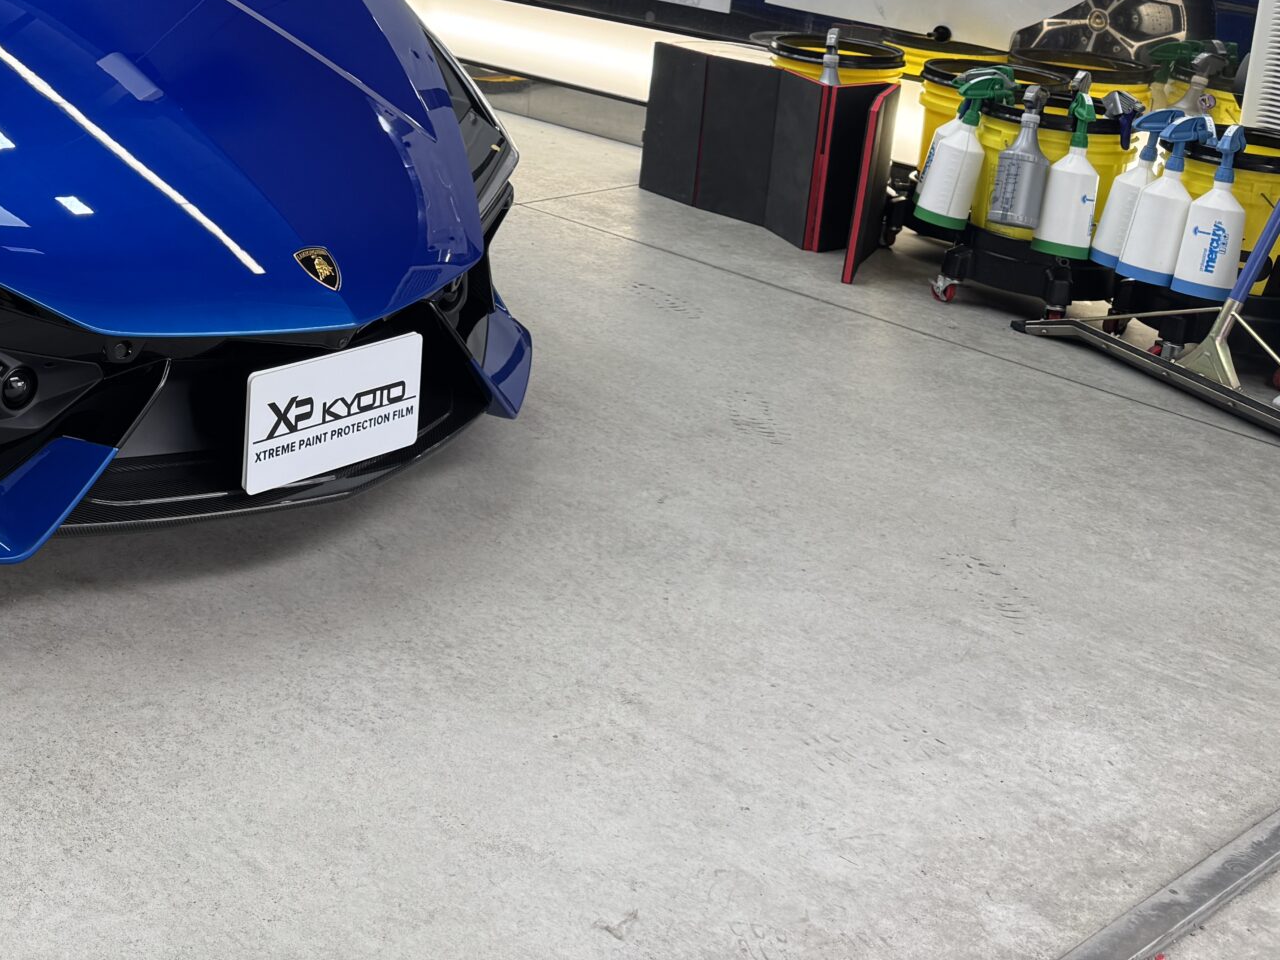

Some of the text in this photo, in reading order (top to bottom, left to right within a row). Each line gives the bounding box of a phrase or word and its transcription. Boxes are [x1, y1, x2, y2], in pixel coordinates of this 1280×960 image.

[1203, 223, 1226, 274] mercury
[254, 405, 414, 463] XTREME PAINT PROTECTION FILM
[266, 380, 406, 440] XP KYOTO
